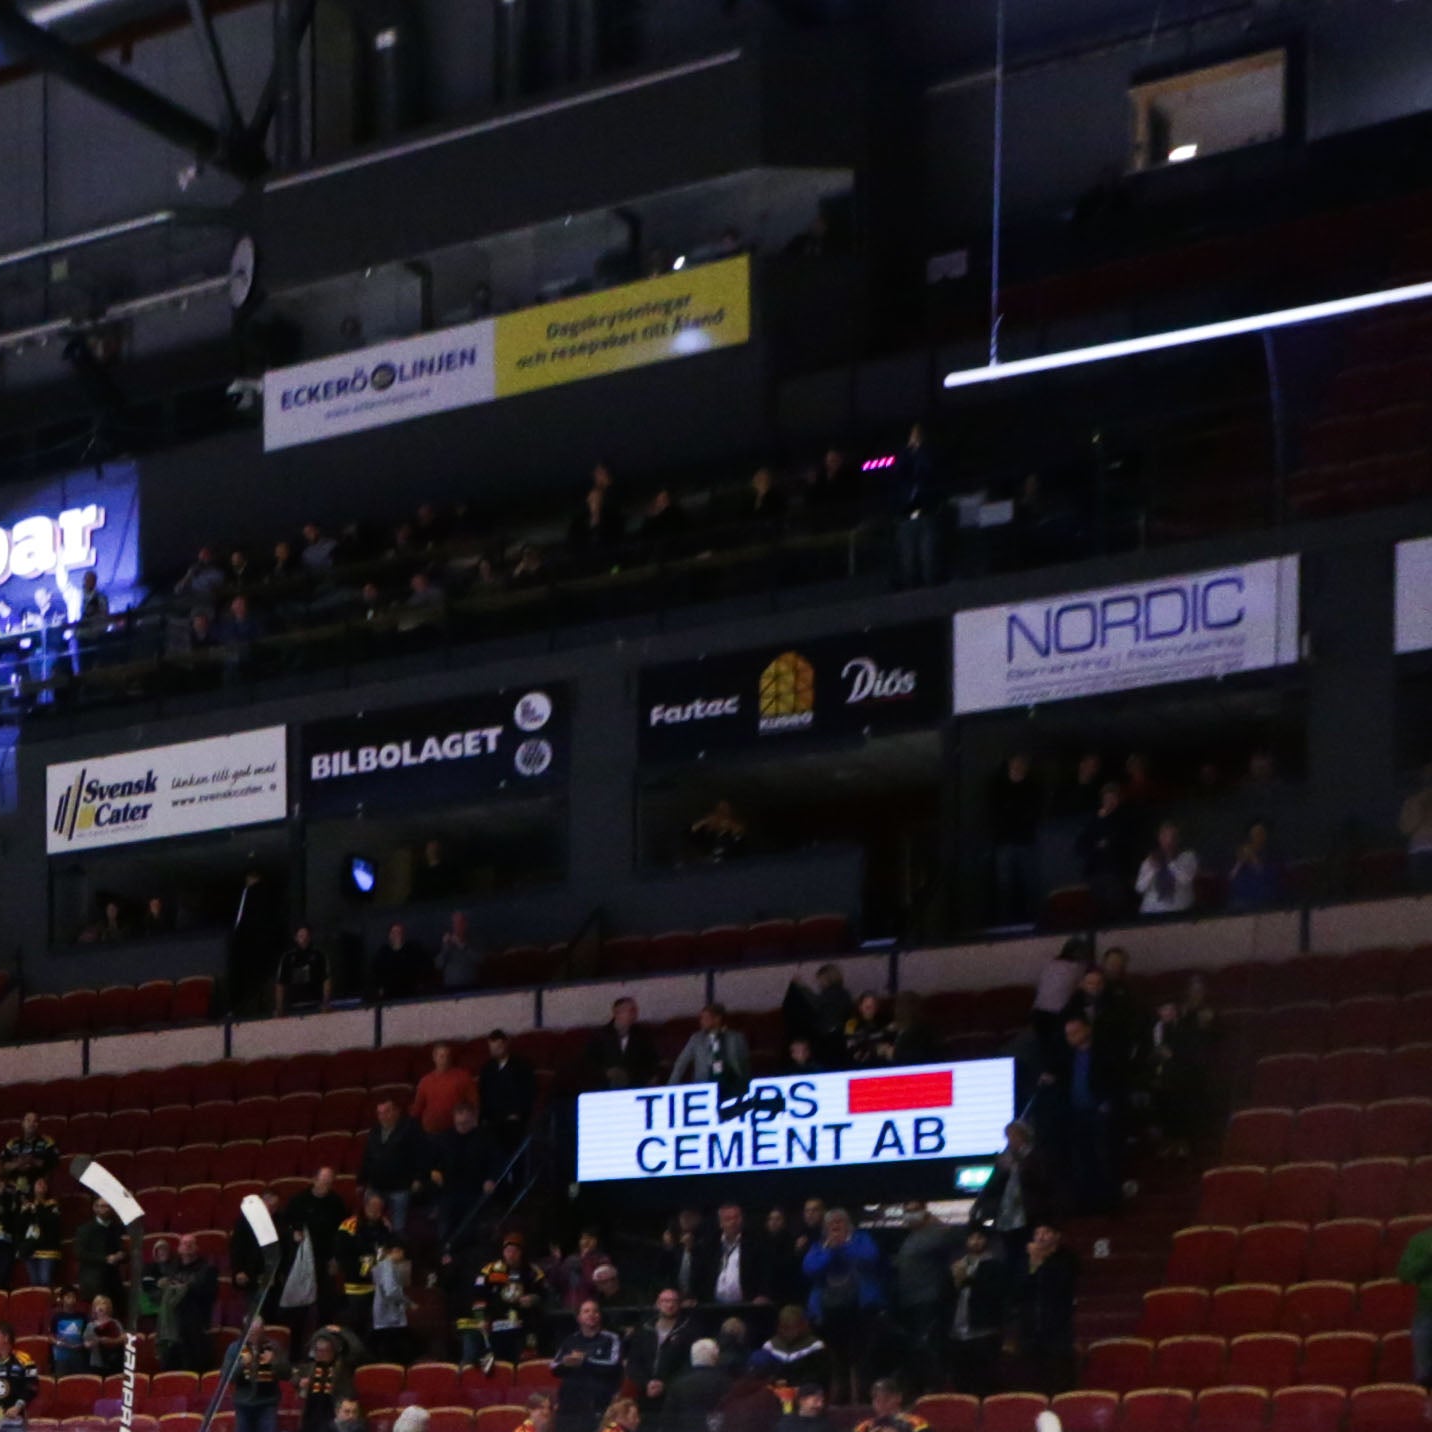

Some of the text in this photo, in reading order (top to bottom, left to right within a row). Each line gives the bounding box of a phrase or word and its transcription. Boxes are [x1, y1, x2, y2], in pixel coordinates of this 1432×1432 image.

[398, 345, 477, 384] LINJEN
[1007, 577, 1245, 664] NORDIC
[841, 656, 916, 704] Diös
[311, 726, 504, 780] BILBOLAGET
[84, 769, 158, 803] Svensk
[95, 802, 152, 827] Cater
[636, 1081, 818, 1130] TIEPS
[636, 1117, 946, 1173] CEMENT AB
